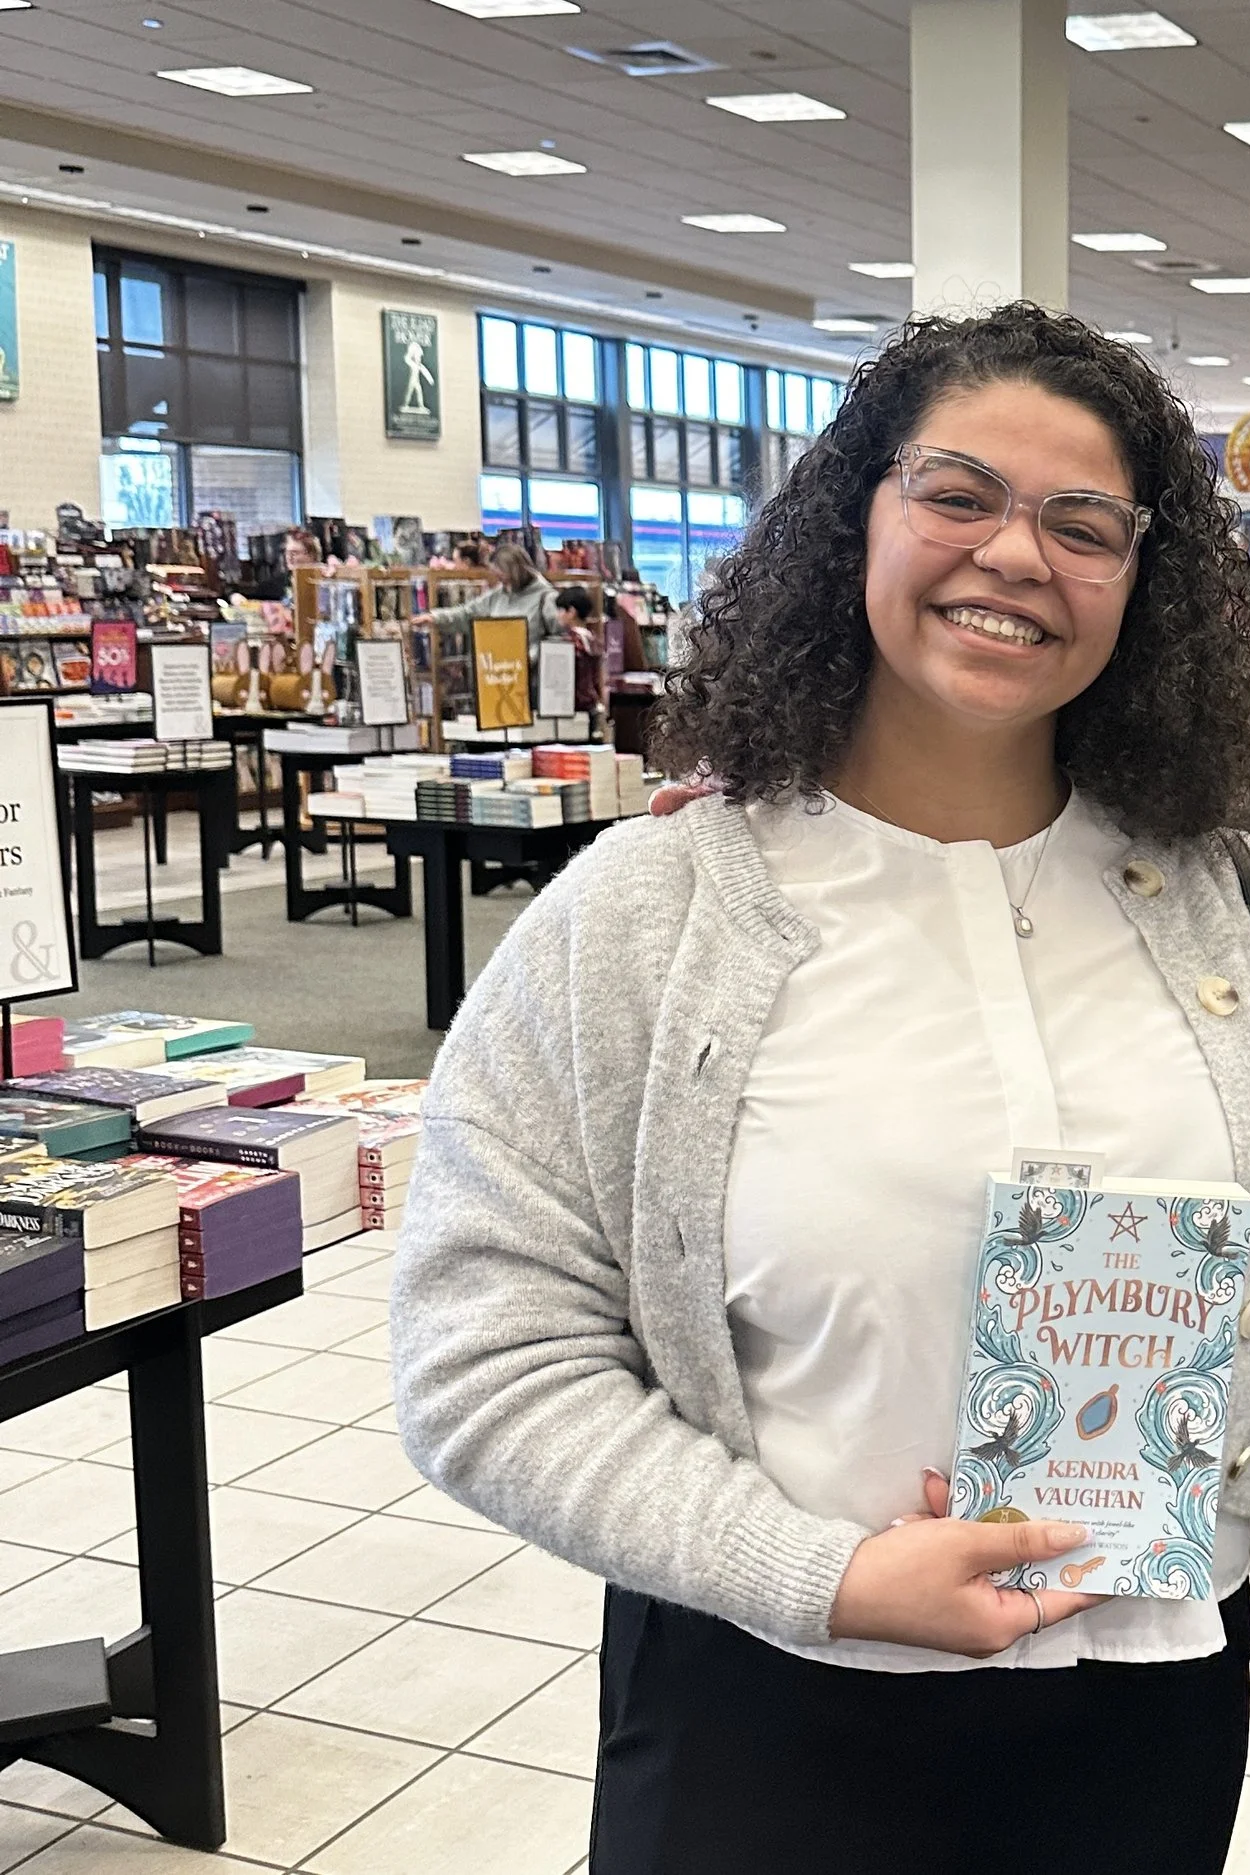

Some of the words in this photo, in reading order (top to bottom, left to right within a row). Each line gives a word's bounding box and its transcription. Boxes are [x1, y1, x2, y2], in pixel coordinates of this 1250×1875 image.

[3, 885, 33, 899] Fantasy
[1102, 1252, 1142, 1270] THE
[1008, 1278, 1218, 1335] PLYMBURY
[1036, 1325, 1176, 1369] WITCH
[1047, 1459, 1140, 1481] KENDRA
[1034, 1486, 1145, 1511] VAUGHAN
[1098, 1542, 1129, 1552] WATSON
